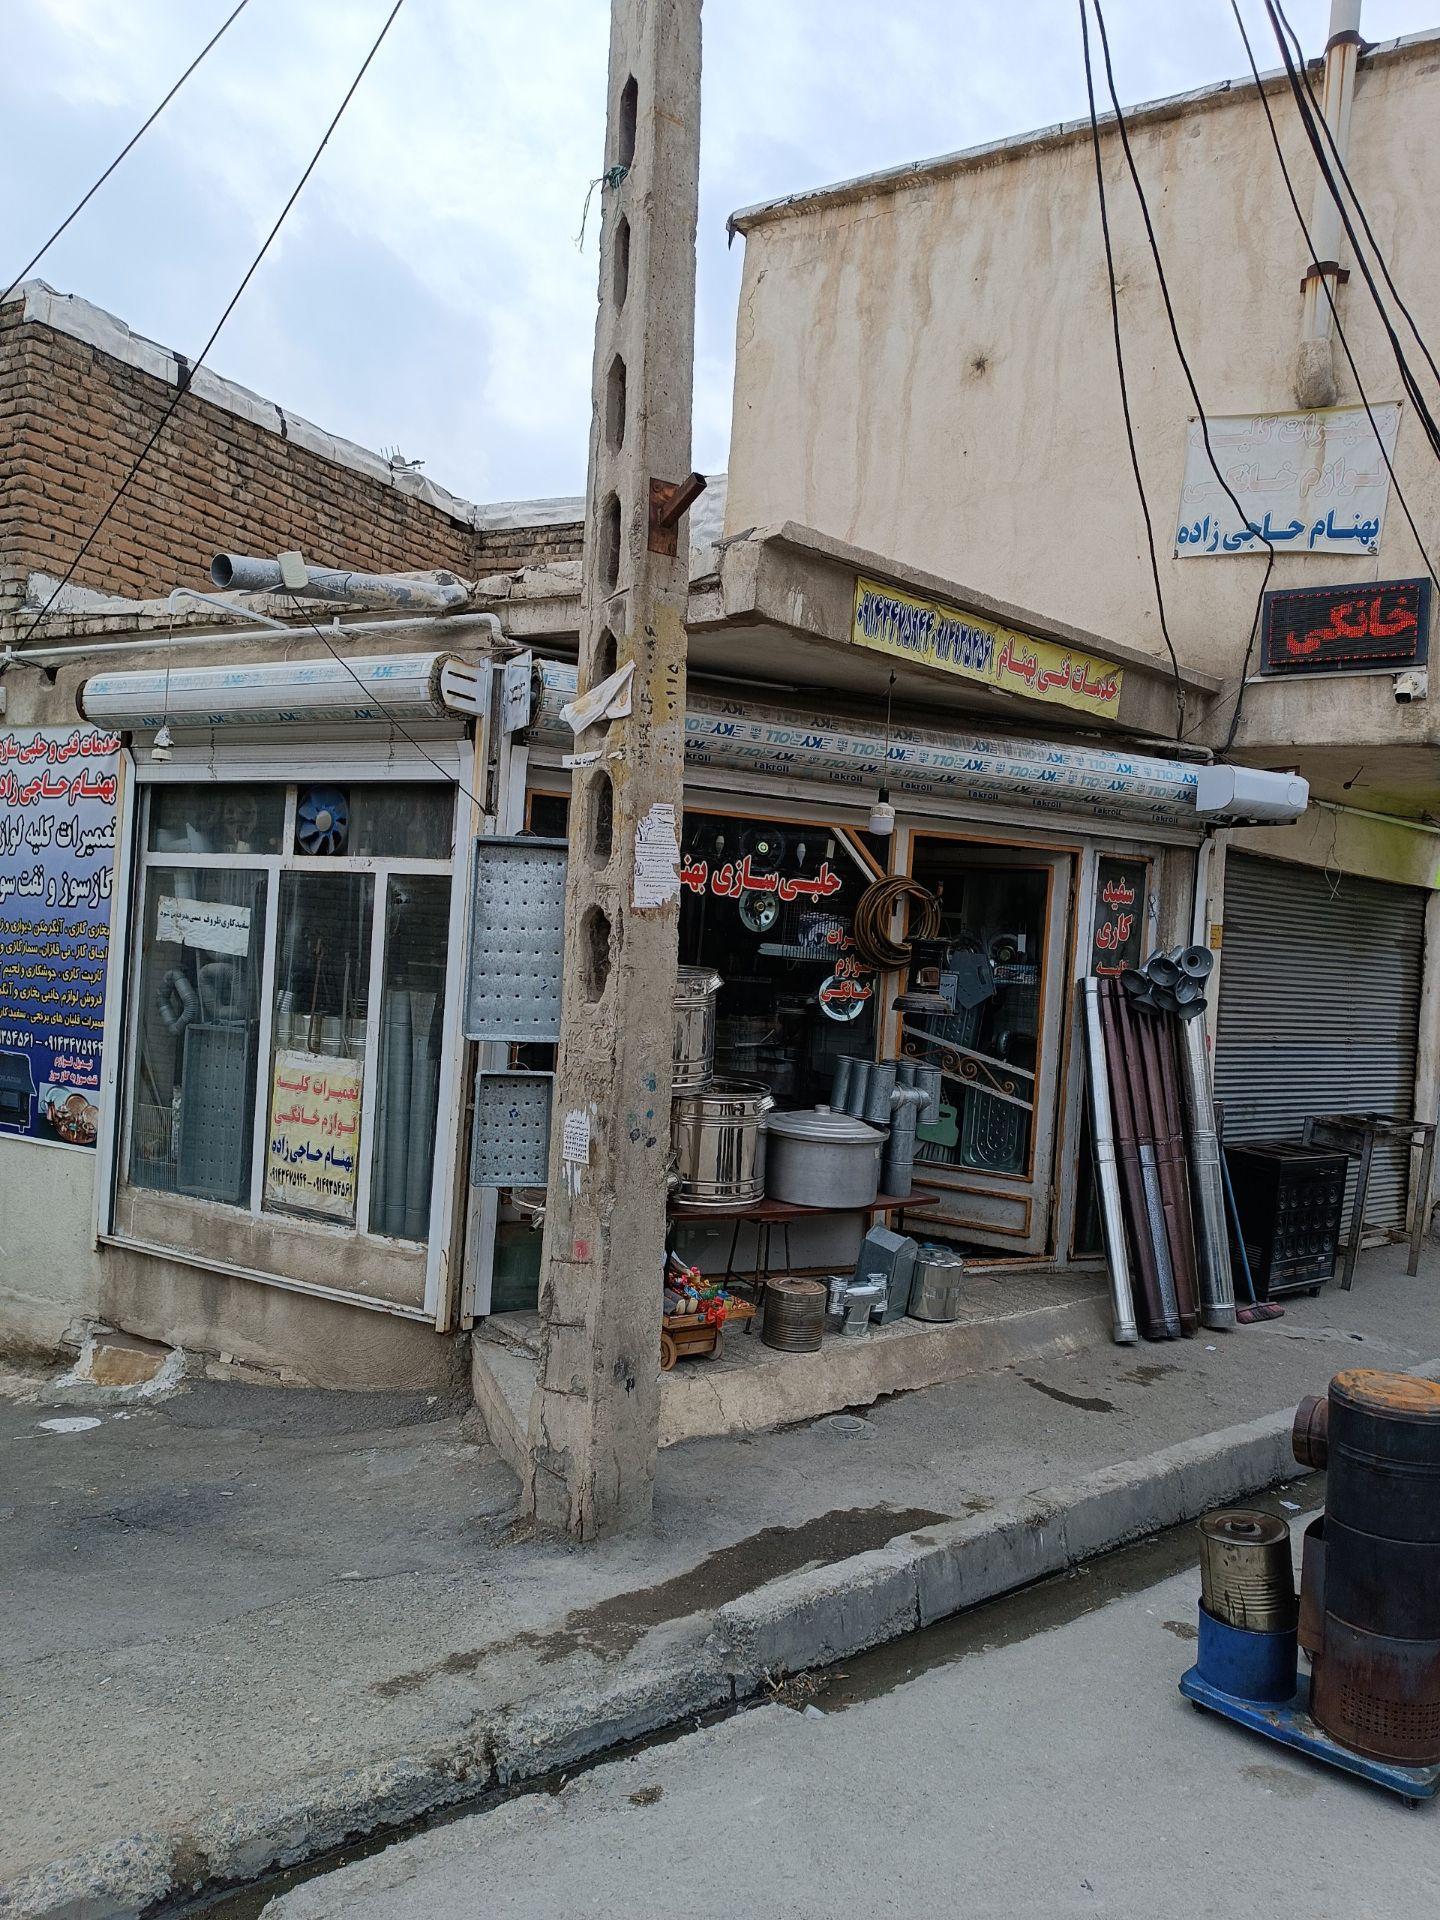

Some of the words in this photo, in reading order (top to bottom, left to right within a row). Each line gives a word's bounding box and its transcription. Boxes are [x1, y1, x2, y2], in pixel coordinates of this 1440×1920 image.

[1191, 416, 1278, 452] کلیه
[1176, 513, 1219, 553] زاده
[1222, 510, 1306, 551] حاجی
[1307, 507, 1382, 550] بهنام
[1287, 596, 1418, 655] خانگی
[996, 635, 1038, 687] بهنام
[1038, 652, 1072, 694] فنی
[1069, 661, 1119, 703] خدمات
[0, 733, 20, 765] ساز
[18, 732, 48, 764] حلبی
[47, 740, 57, 763] و
[57, 730, 80, 762] فنی
[80, 730, 121, 757] خدمات
[19, 769, 71, 806] حاجی
[70, 767, 117, 805] بهنام
[0, 814, 24, 856] لواز
[25, 814, 54, 855] کلیه
[17, 864, 44, 897] نفت
[680, 855, 708, 894] بهن
[711, 855, 779, 898] سازی
[778, 862, 842, 903] حلبی
[46, 877, 57, 907] و
[1103, 876, 1134, 911] سفید
[10, 918, 33, 935] دیواری
[33, 917, 65, 937] آبگرمکن
[88, 923, 110, 940] بخاری
[204, 916, 222, 927] ظروف
[1096, 912, 1133, 950] کاری
[88, 944, 109, 962] اجاق
[3, 962, 20, 979] لحیم
[26, 963, 56, 981] جوشکاری
[13, 987, 19, 1000] و
[19, 985, 41, 1002] بخاری
[41, 987, 60, 1003] جانبی
[60, 989, 80, 1007] لوازم
[80, 991, 103, 1008] فروش
[821, 980, 873, 1002] خانگی
[50, 1011, 63, 1025] های
[64, 1013, 81, 1027] قلیان
[0, 1029, 33, 1048] ۳۵۴۵۶۱
[54, 1055, 73, 1069] لوازم
[73, 1057, 94, 1071] تبدیل
[276, 1075, 311, 1097] کلیه
[313, 1076, 360, 1102] تعمیرات
[274, 1105, 319, 1125] خانگی
[321, 1111, 358, 1136] لوازم
[271, 1136, 289, 1161] زاده
[290, 1141, 323, 1164] حاجی
[325, 1145, 354, 1173] بهنام
